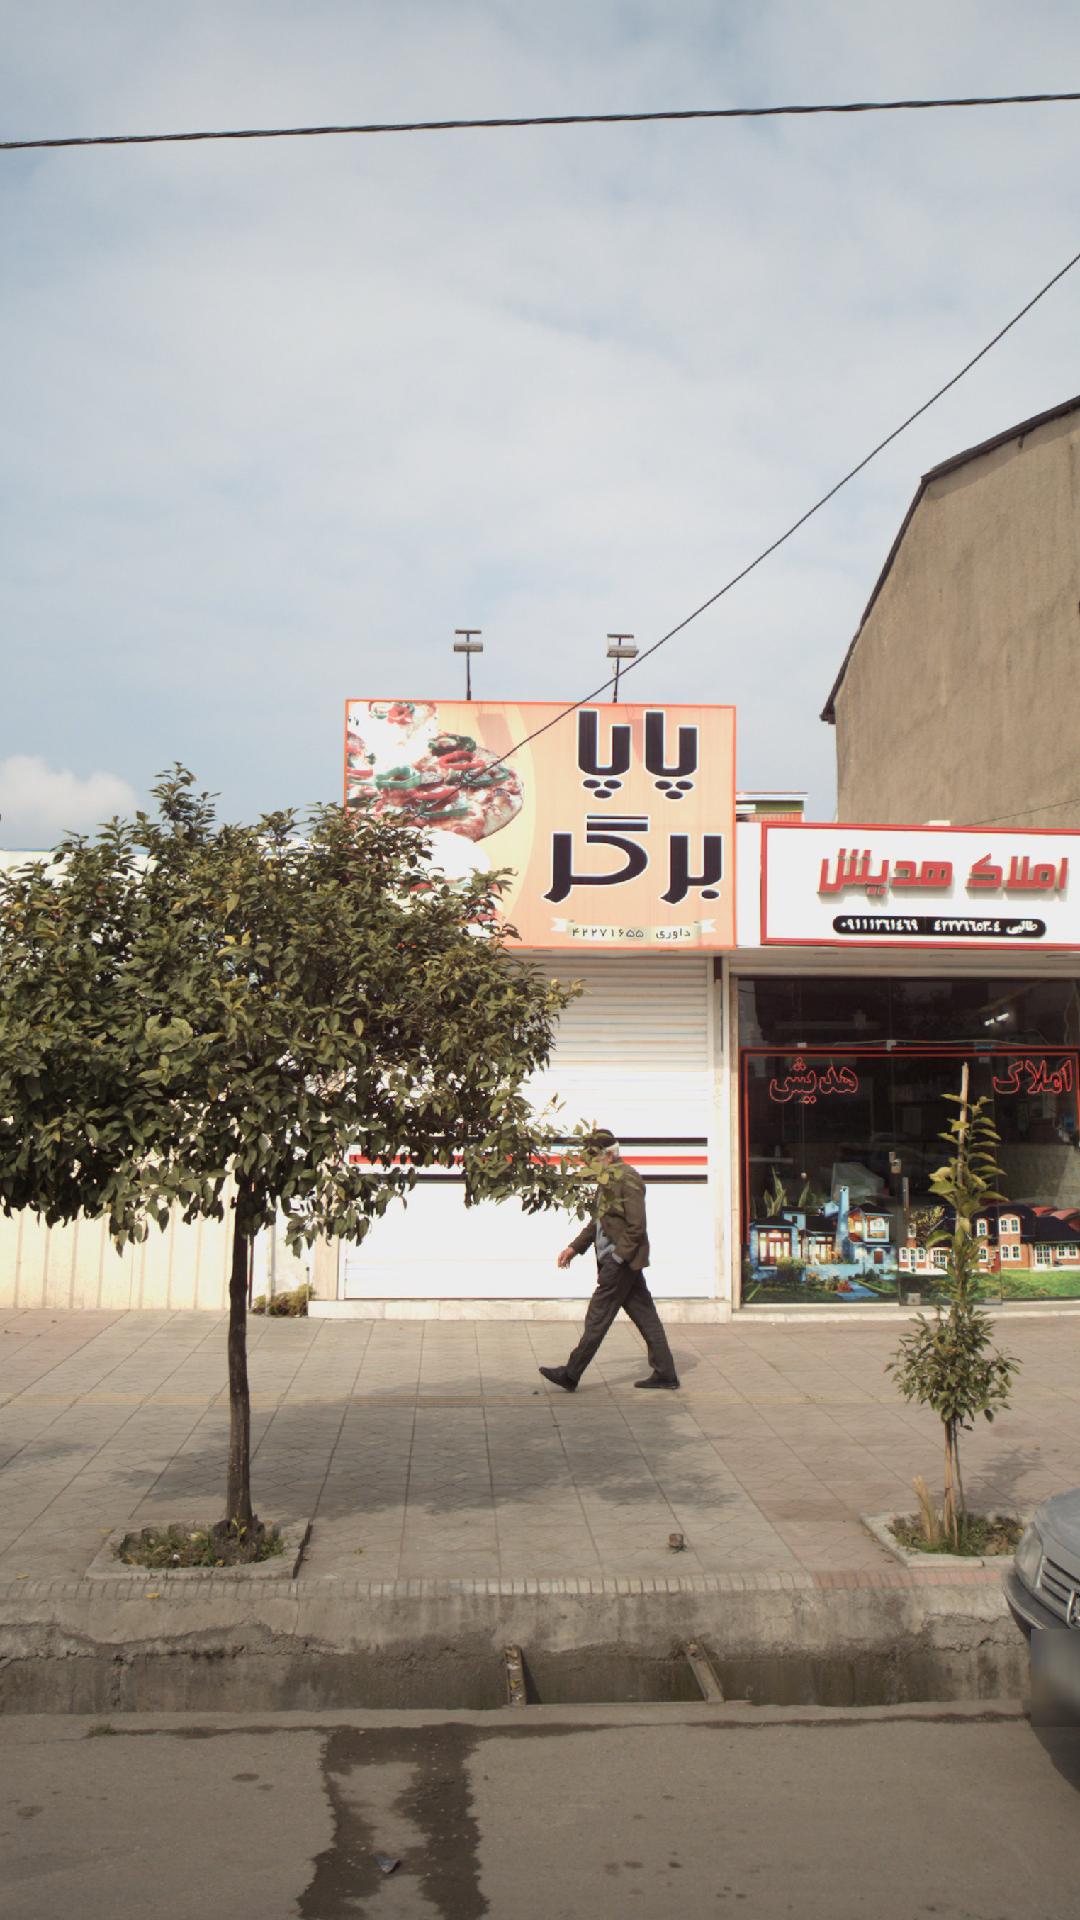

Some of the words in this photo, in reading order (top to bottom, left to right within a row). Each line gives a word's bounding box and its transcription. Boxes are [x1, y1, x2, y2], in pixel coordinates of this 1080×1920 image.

[577, 709, 698, 800] پاپا
[543, 814, 723, 905] برگر
[817, 848, 953, 896] هدیش
[965, 853, 1069, 890] املاک
[572, 927, 644, 938] ۴۲۲۷۱۶۵۵
[655, 927, 691, 939] داوری
[769, 1057, 859, 1104] هدیش
[992, 1060, 1073, 1095] املاک
